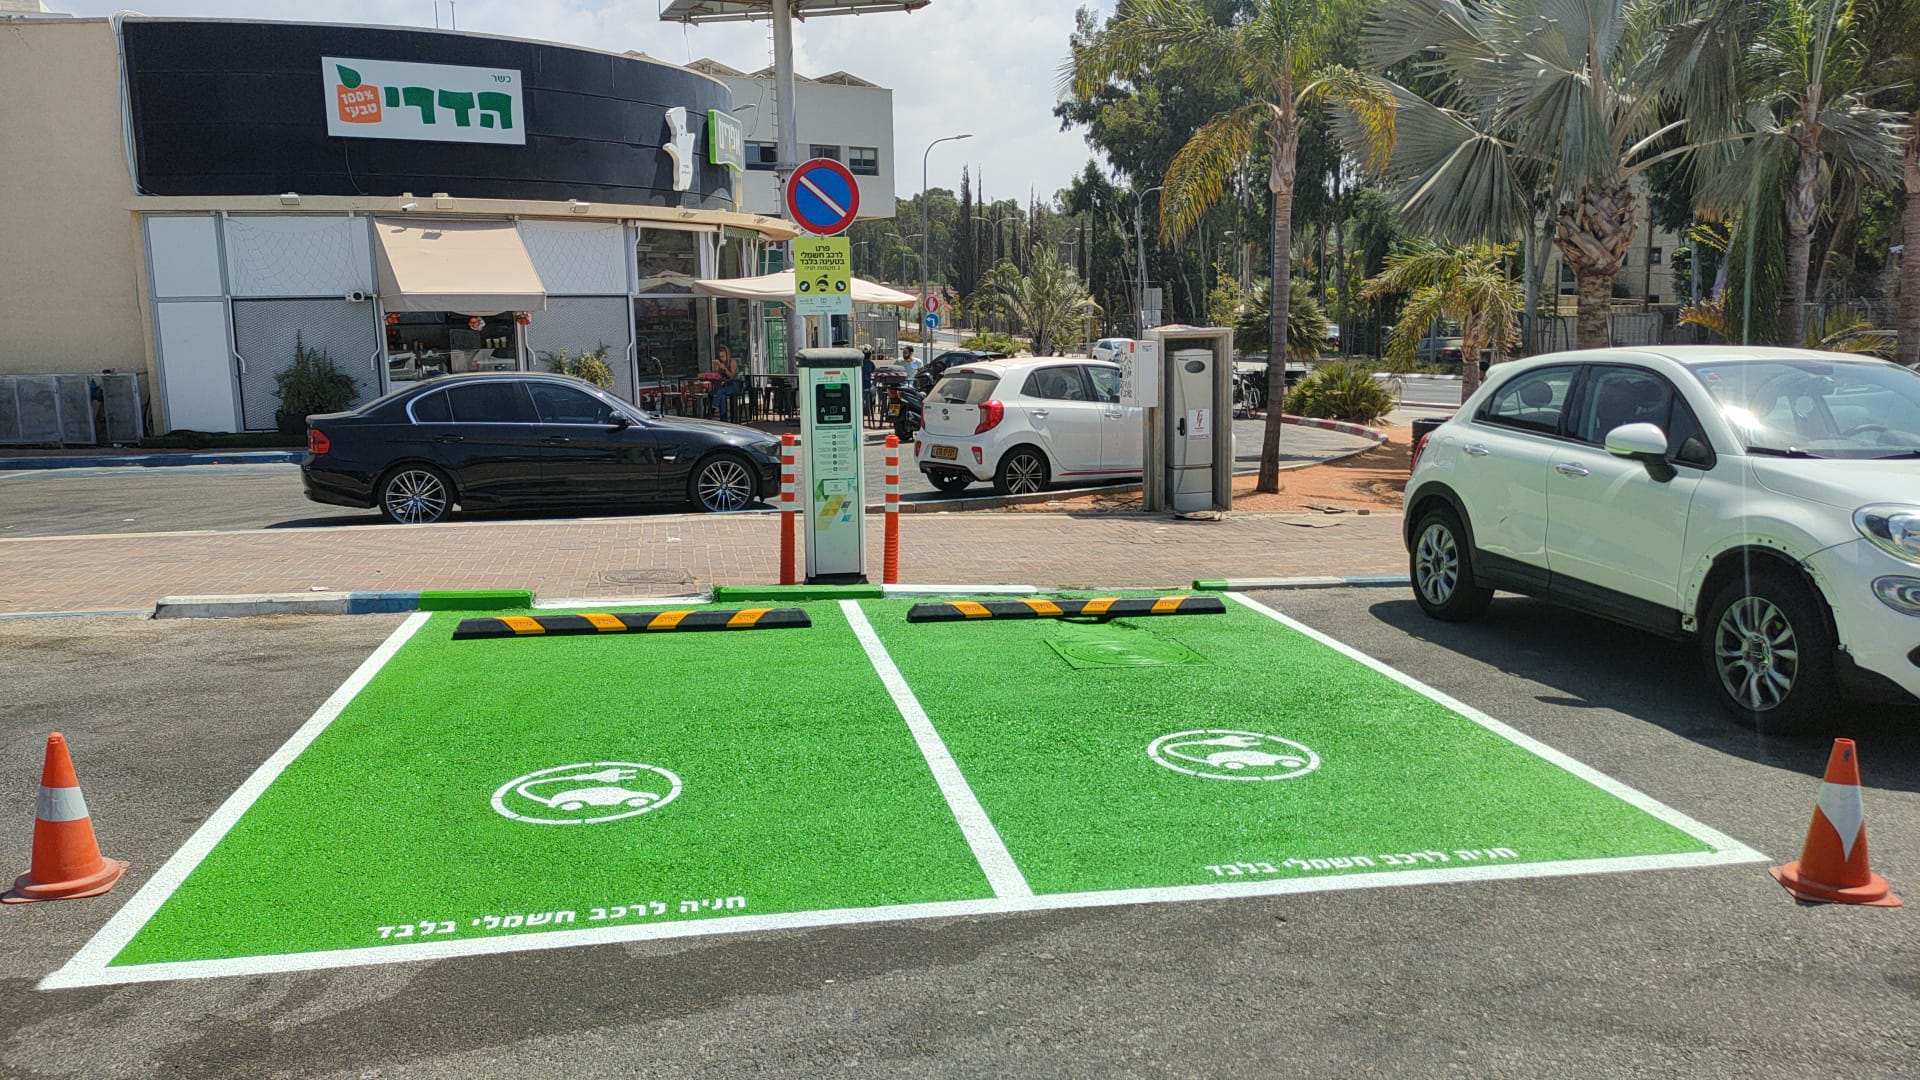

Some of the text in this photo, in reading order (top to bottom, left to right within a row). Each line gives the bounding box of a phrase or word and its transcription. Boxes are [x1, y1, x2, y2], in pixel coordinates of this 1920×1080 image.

[490, 74, 512, 84] כשר
[344, 104, 378, 119] טבעי
[383, 86, 513, 130] הדרי
[1204, 845, 1519, 877] חניה לרכב חשמלי בלבד
[376, 896, 746, 939] חניה לרכב חשמלי בלבד
